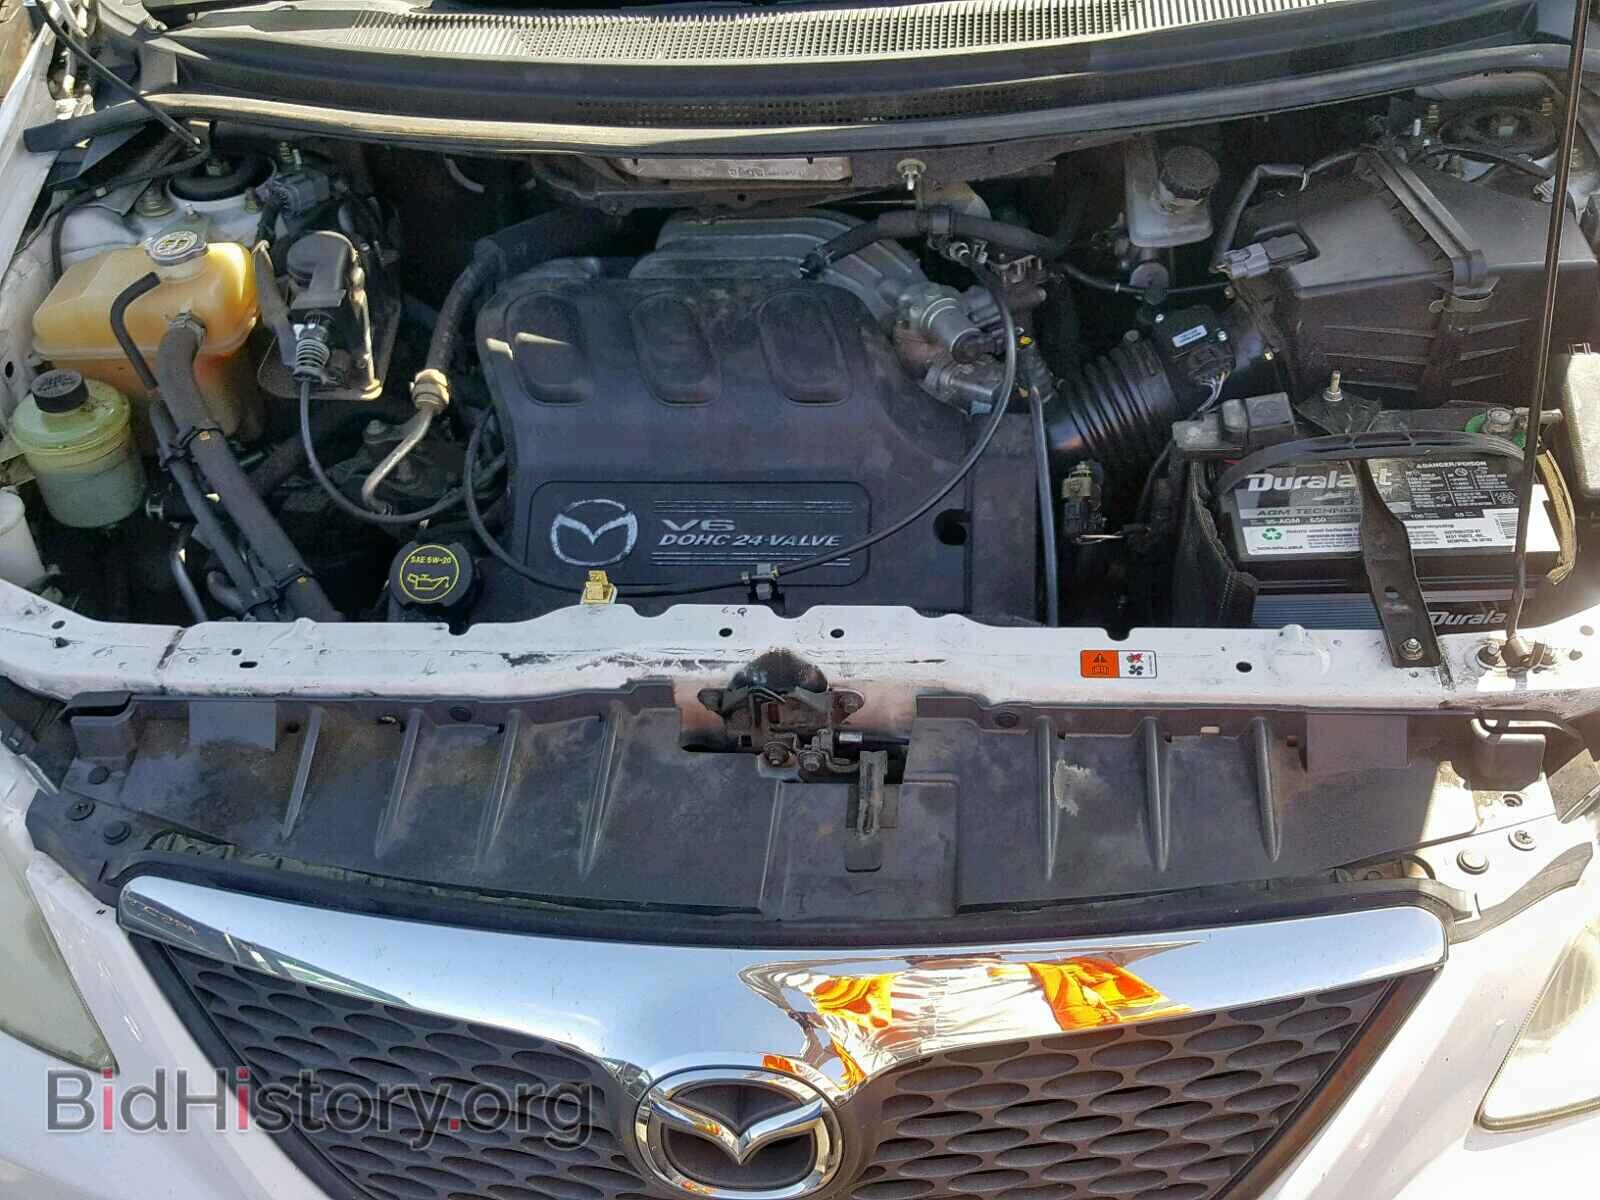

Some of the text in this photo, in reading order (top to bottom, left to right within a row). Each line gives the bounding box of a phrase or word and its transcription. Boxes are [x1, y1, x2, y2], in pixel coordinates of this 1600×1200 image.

[1247, 469, 1393, 492] Duralat
[1256, 506, 1290, 516] AGM
[661, 518, 737, 532] V6
[658, 534, 731, 547] DOHC
[410, 555, 452, 564] SAE 5W-20
